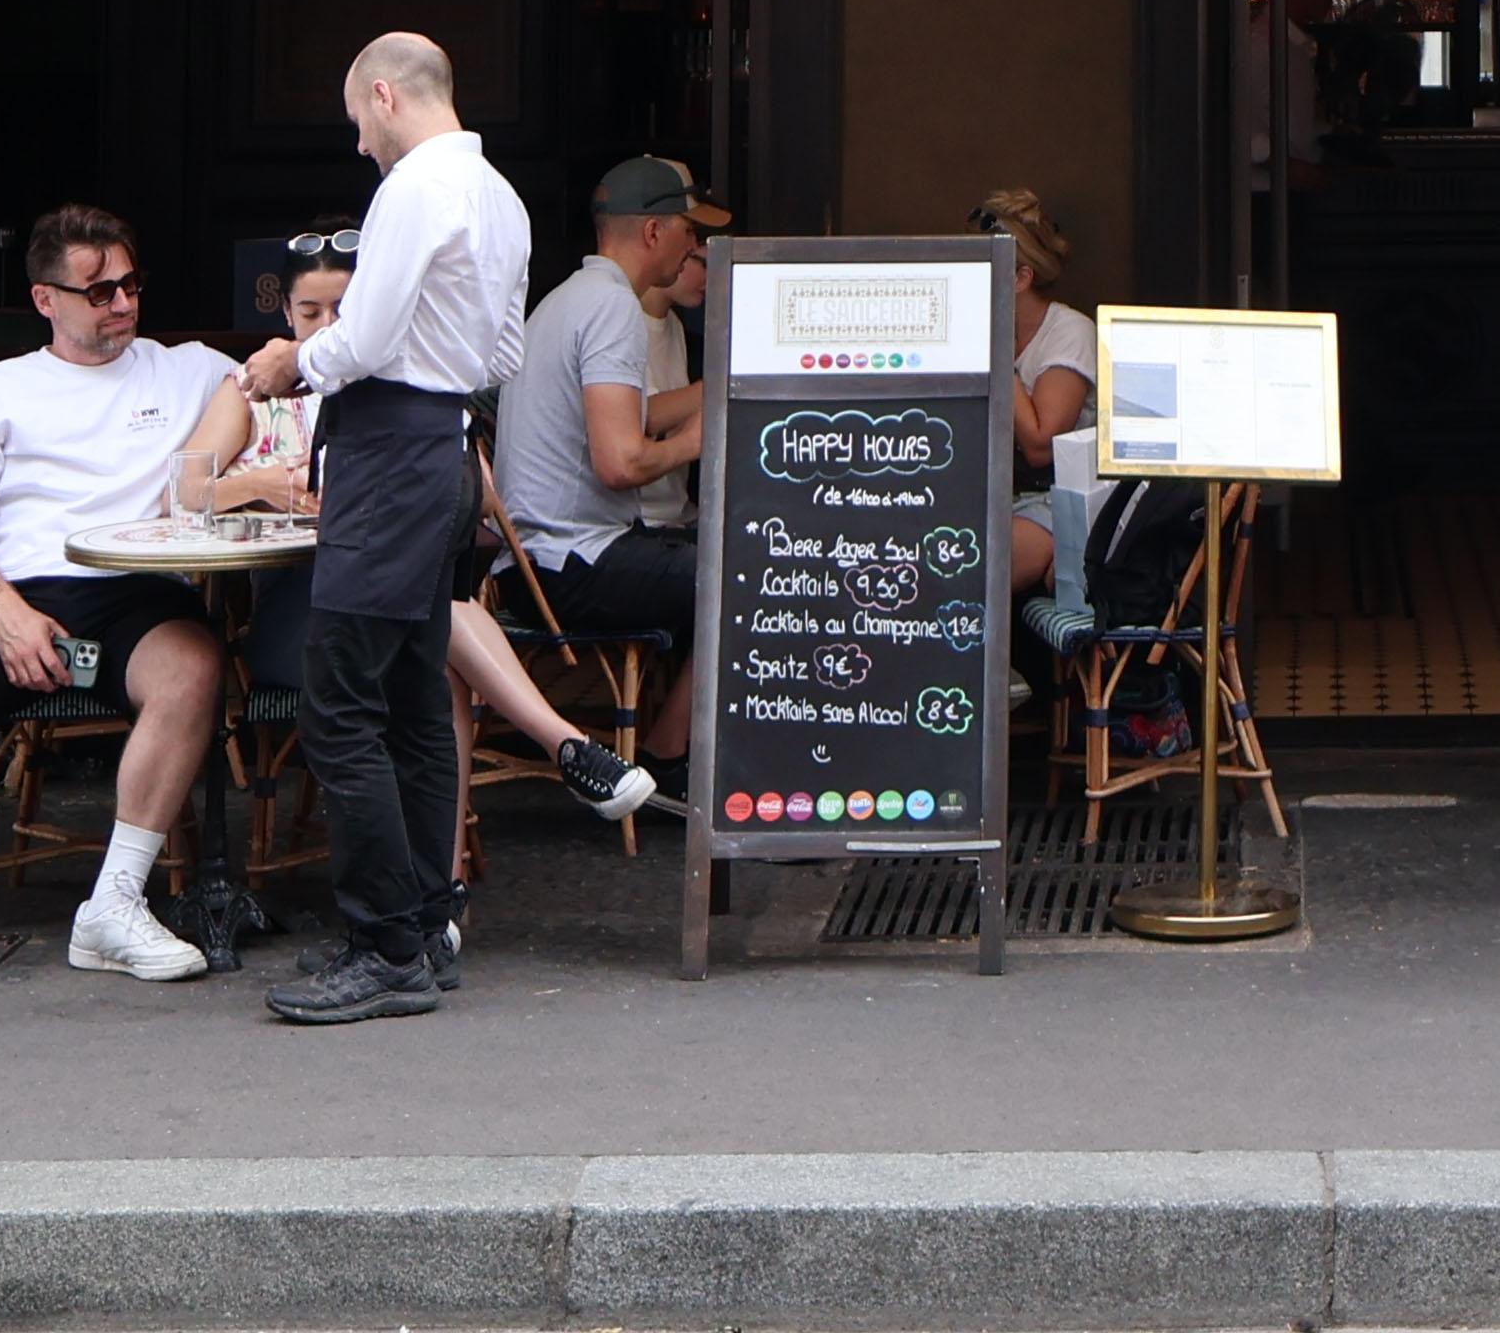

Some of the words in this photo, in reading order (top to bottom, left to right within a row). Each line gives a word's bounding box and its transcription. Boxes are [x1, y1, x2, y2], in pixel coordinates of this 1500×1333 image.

[782, 428, 853, 463] HAPPY
[864, 434, 931, 461] HOURS
[827, 533, 879, 568] lager
[937, 540, 965, 564] 8€
[759, 566, 840, 597] Cocktails
[750, 609, 820, 634] Cocktails
[824, 620, 846, 635] au
[947, 616, 984, 637] 12€
[822, 653, 853, 678] 9€
[745, 694, 818, 722] Mocktails
[822, 703, 855, 724] sans
[858, 699, 909, 726] Alcool
[927, 699, 960, 722] 8€
